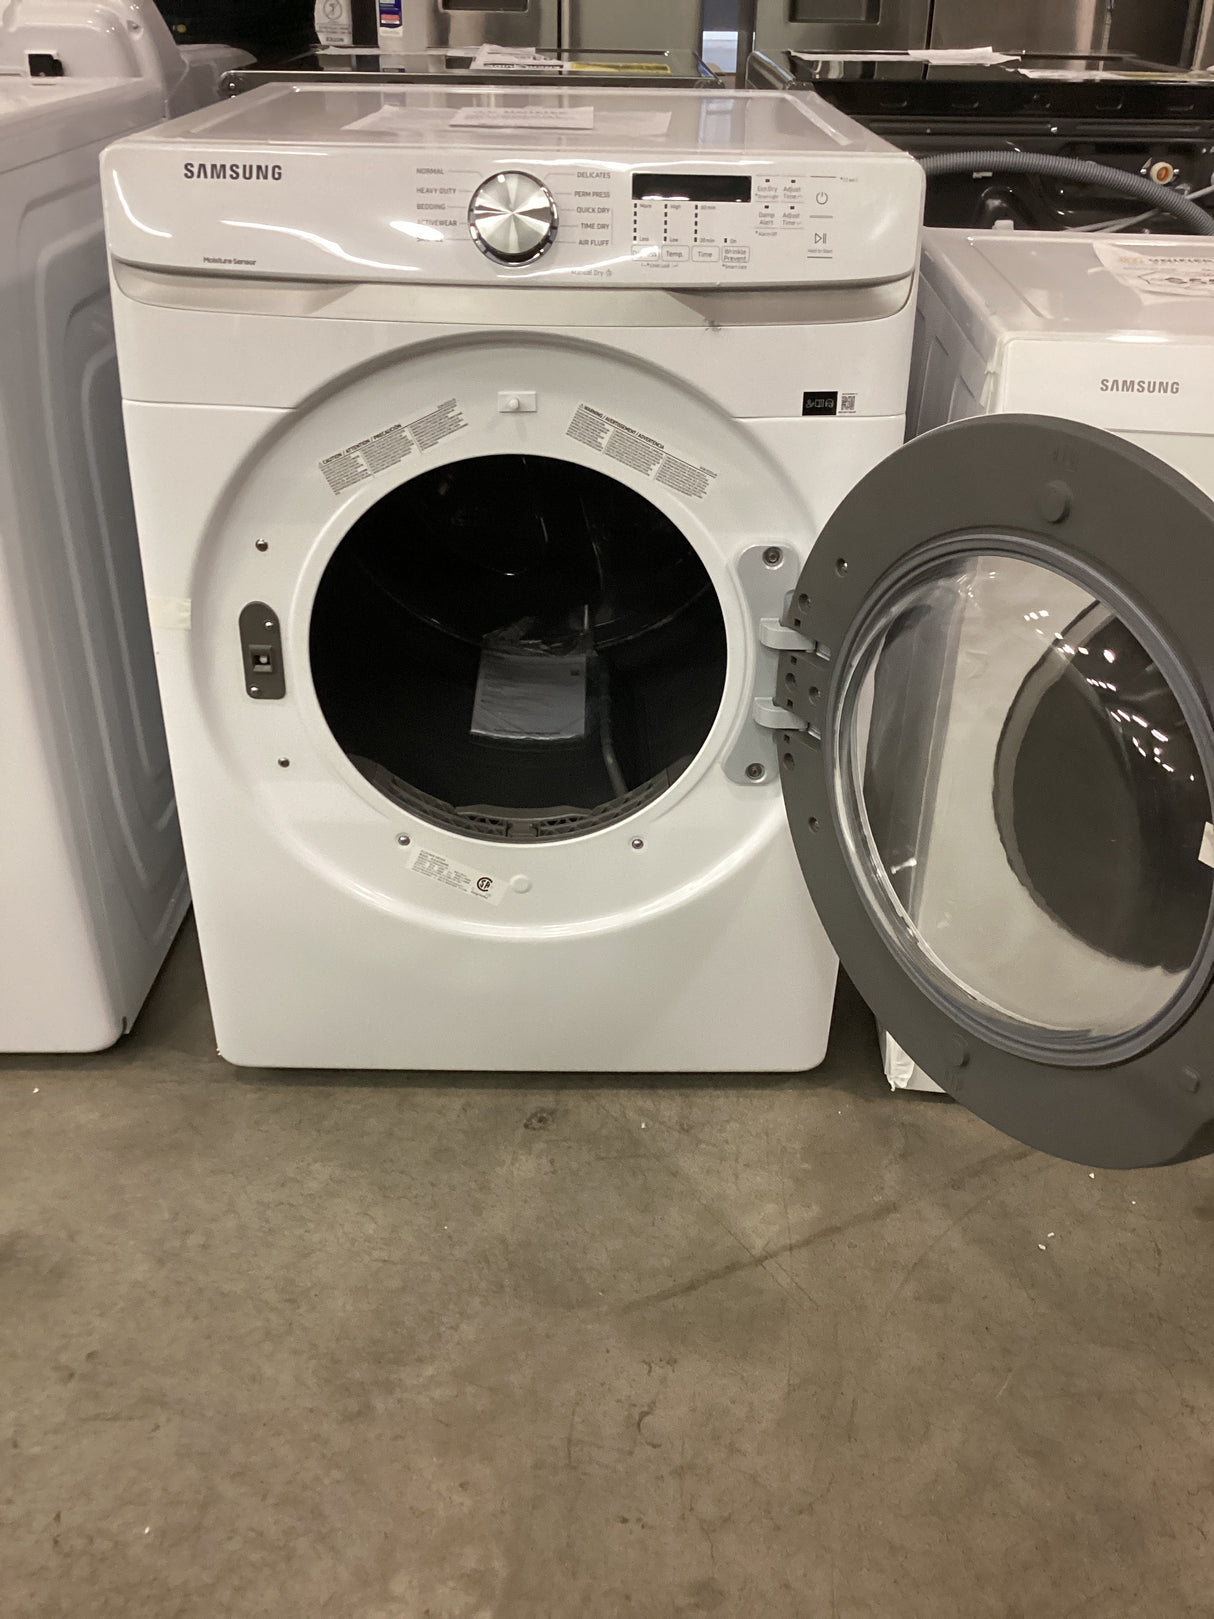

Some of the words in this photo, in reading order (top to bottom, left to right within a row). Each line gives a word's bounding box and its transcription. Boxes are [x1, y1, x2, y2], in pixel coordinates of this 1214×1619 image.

[184, 162, 282, 181] SAMSUNG
[203, 257, 232, 265] Moisture
[666, 250, 683, 258] Temp.
[1100, 378, 1180, 394] SAMSUNG
[584, 405, 603, 419] WARNING
[322, 453, 343, 465] CAUTION
[346, 437, 370, 453] ATTENTION
